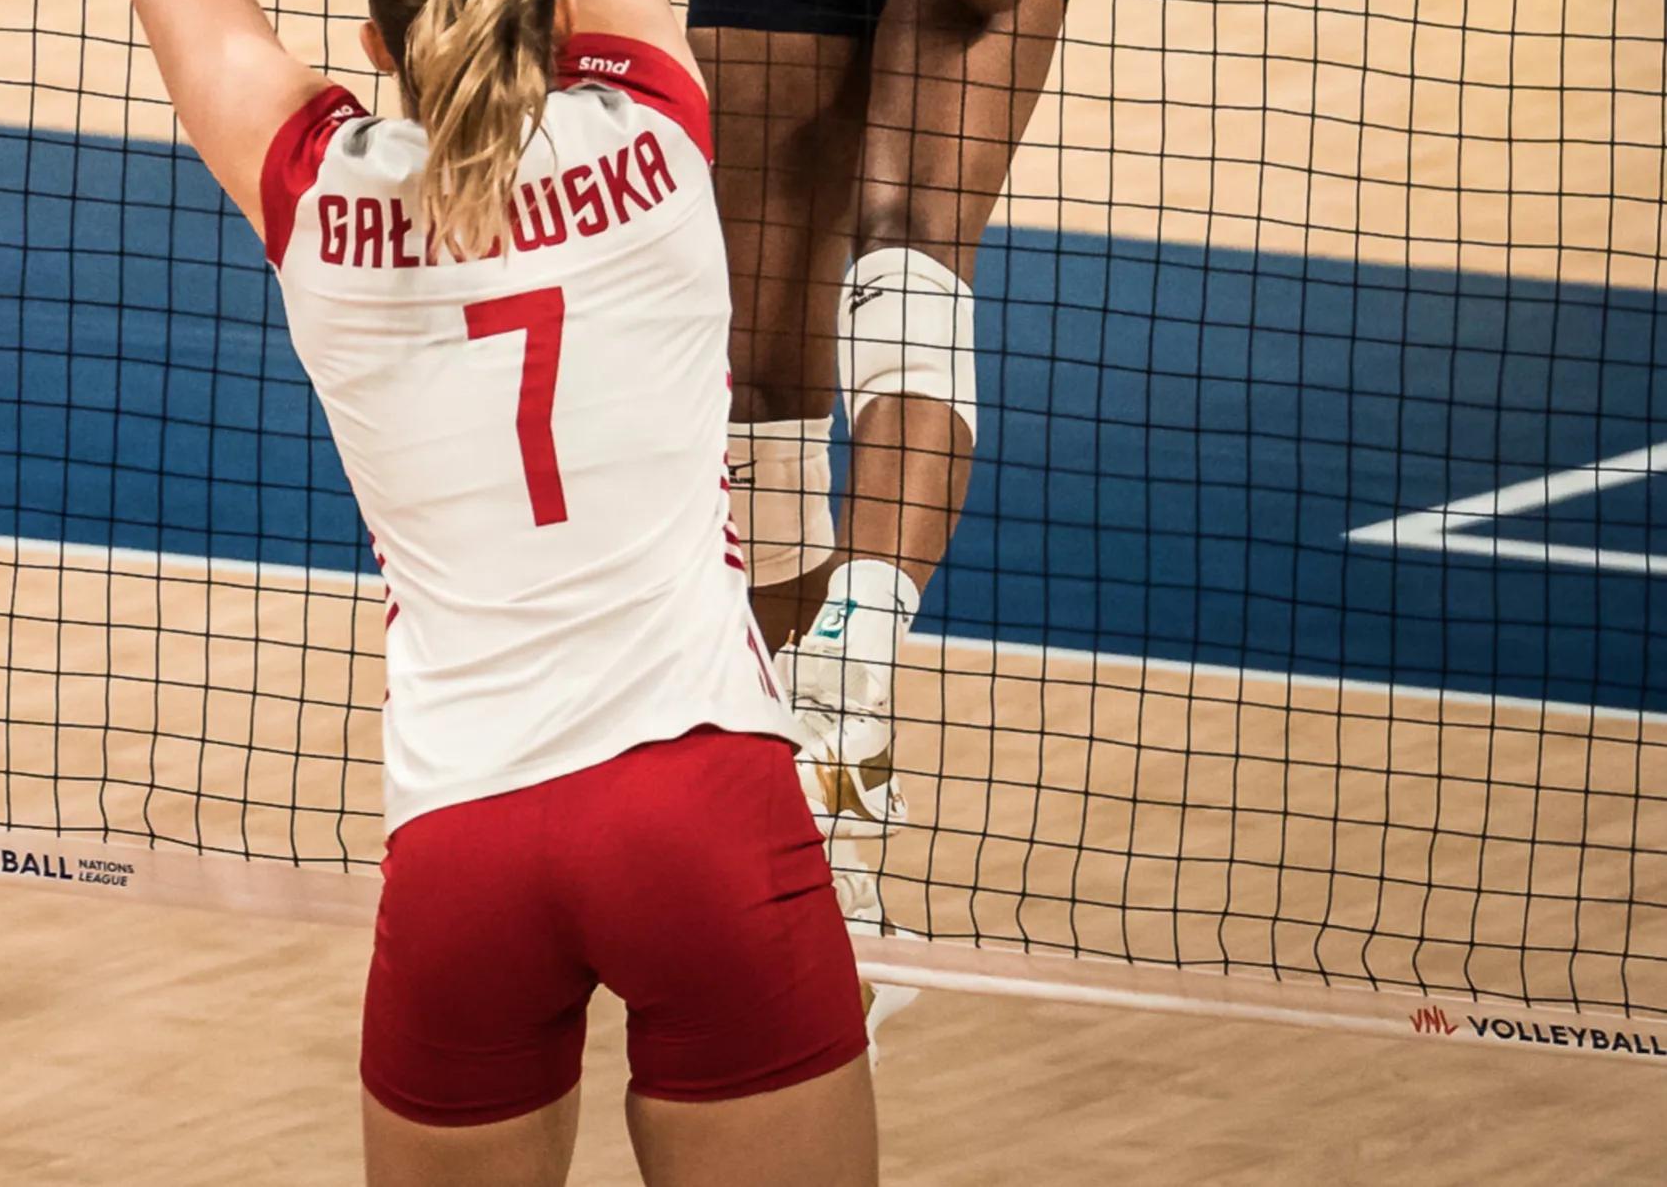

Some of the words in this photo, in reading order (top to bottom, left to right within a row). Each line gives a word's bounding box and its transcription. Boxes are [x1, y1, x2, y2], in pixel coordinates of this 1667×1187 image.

[318, 130, 677, 269] GAŁWSKA
[462, 286, 569, 527] 7
[78, 859, 135, 874] NATIONS
[78, 872, 129, 887] LEAGUE
[1467, 1015, 1667, 1056] VOLLEYBALL
